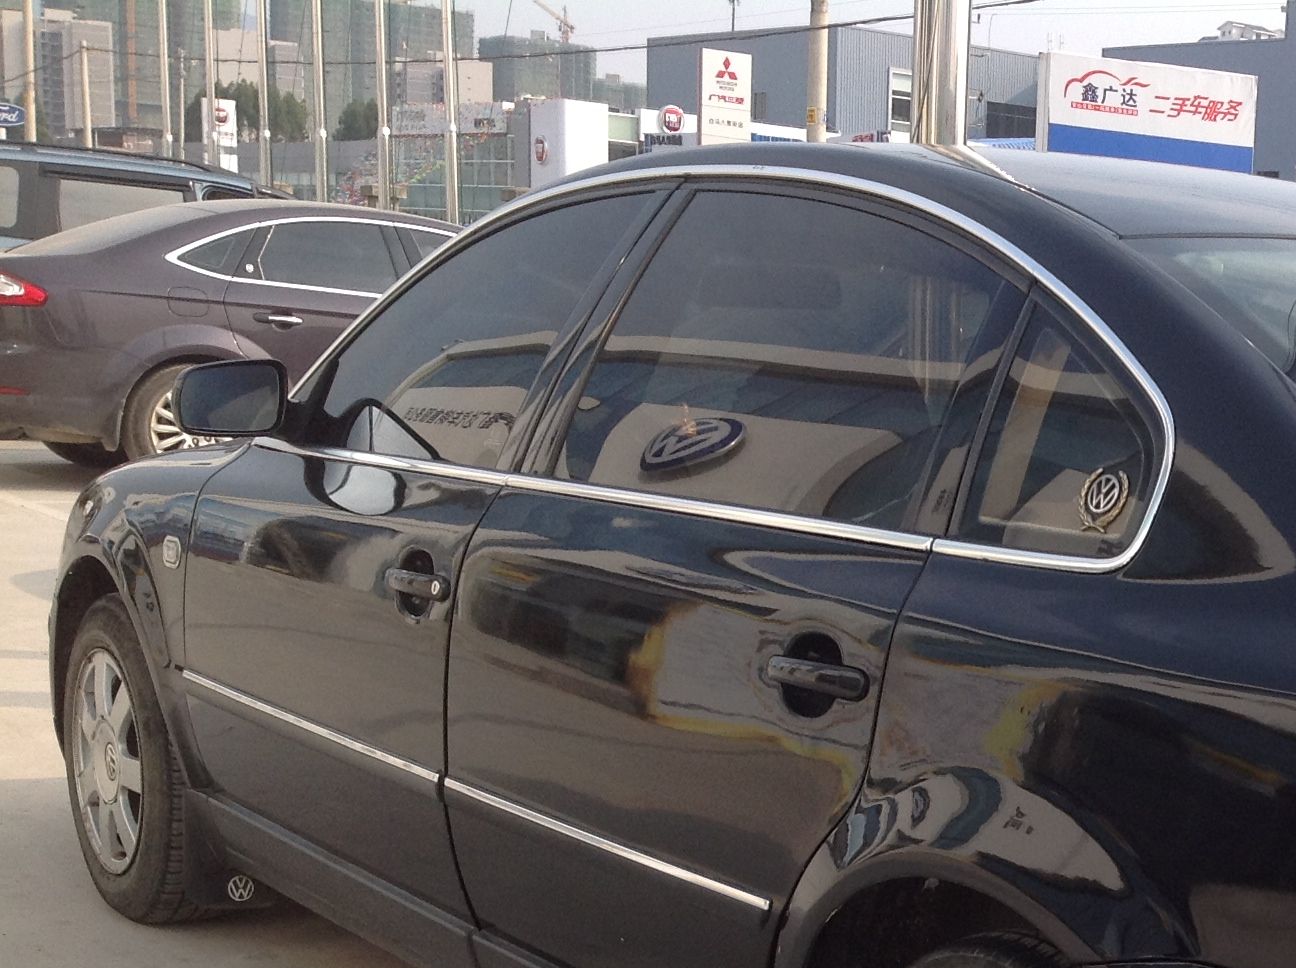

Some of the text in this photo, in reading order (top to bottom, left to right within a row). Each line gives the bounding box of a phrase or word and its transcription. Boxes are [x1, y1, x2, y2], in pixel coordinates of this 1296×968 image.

[1081, 82, 1138, 108] 鑫广达
[1149, 95, 1242, 122] 二手车服务
